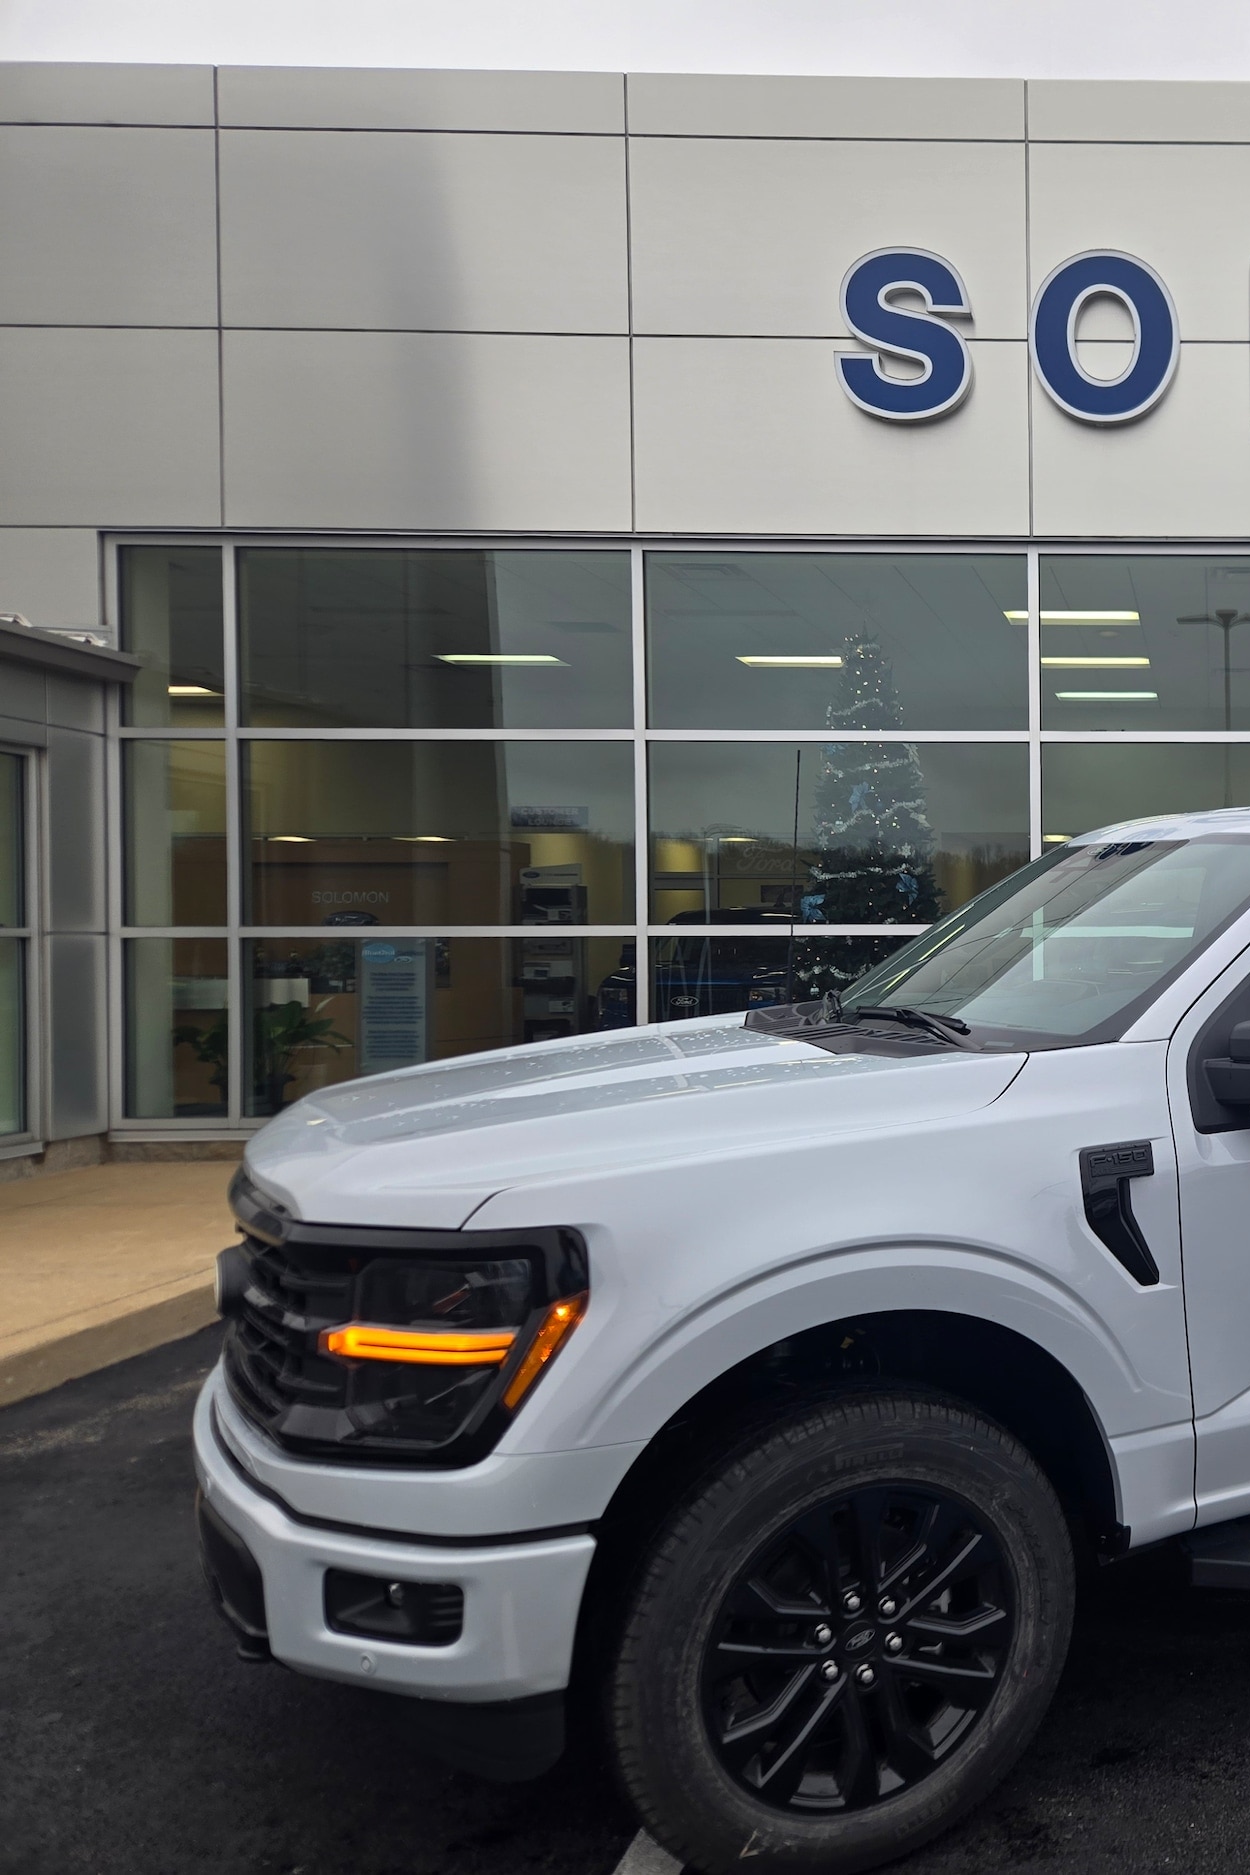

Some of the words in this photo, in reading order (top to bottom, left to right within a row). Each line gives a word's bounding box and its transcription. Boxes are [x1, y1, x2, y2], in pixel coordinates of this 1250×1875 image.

[520, 807, 579, 816] CUSTOMER
[527, 818, 574, 826] LOUNGE
[311, 890, 389, 903] SOLOMON
